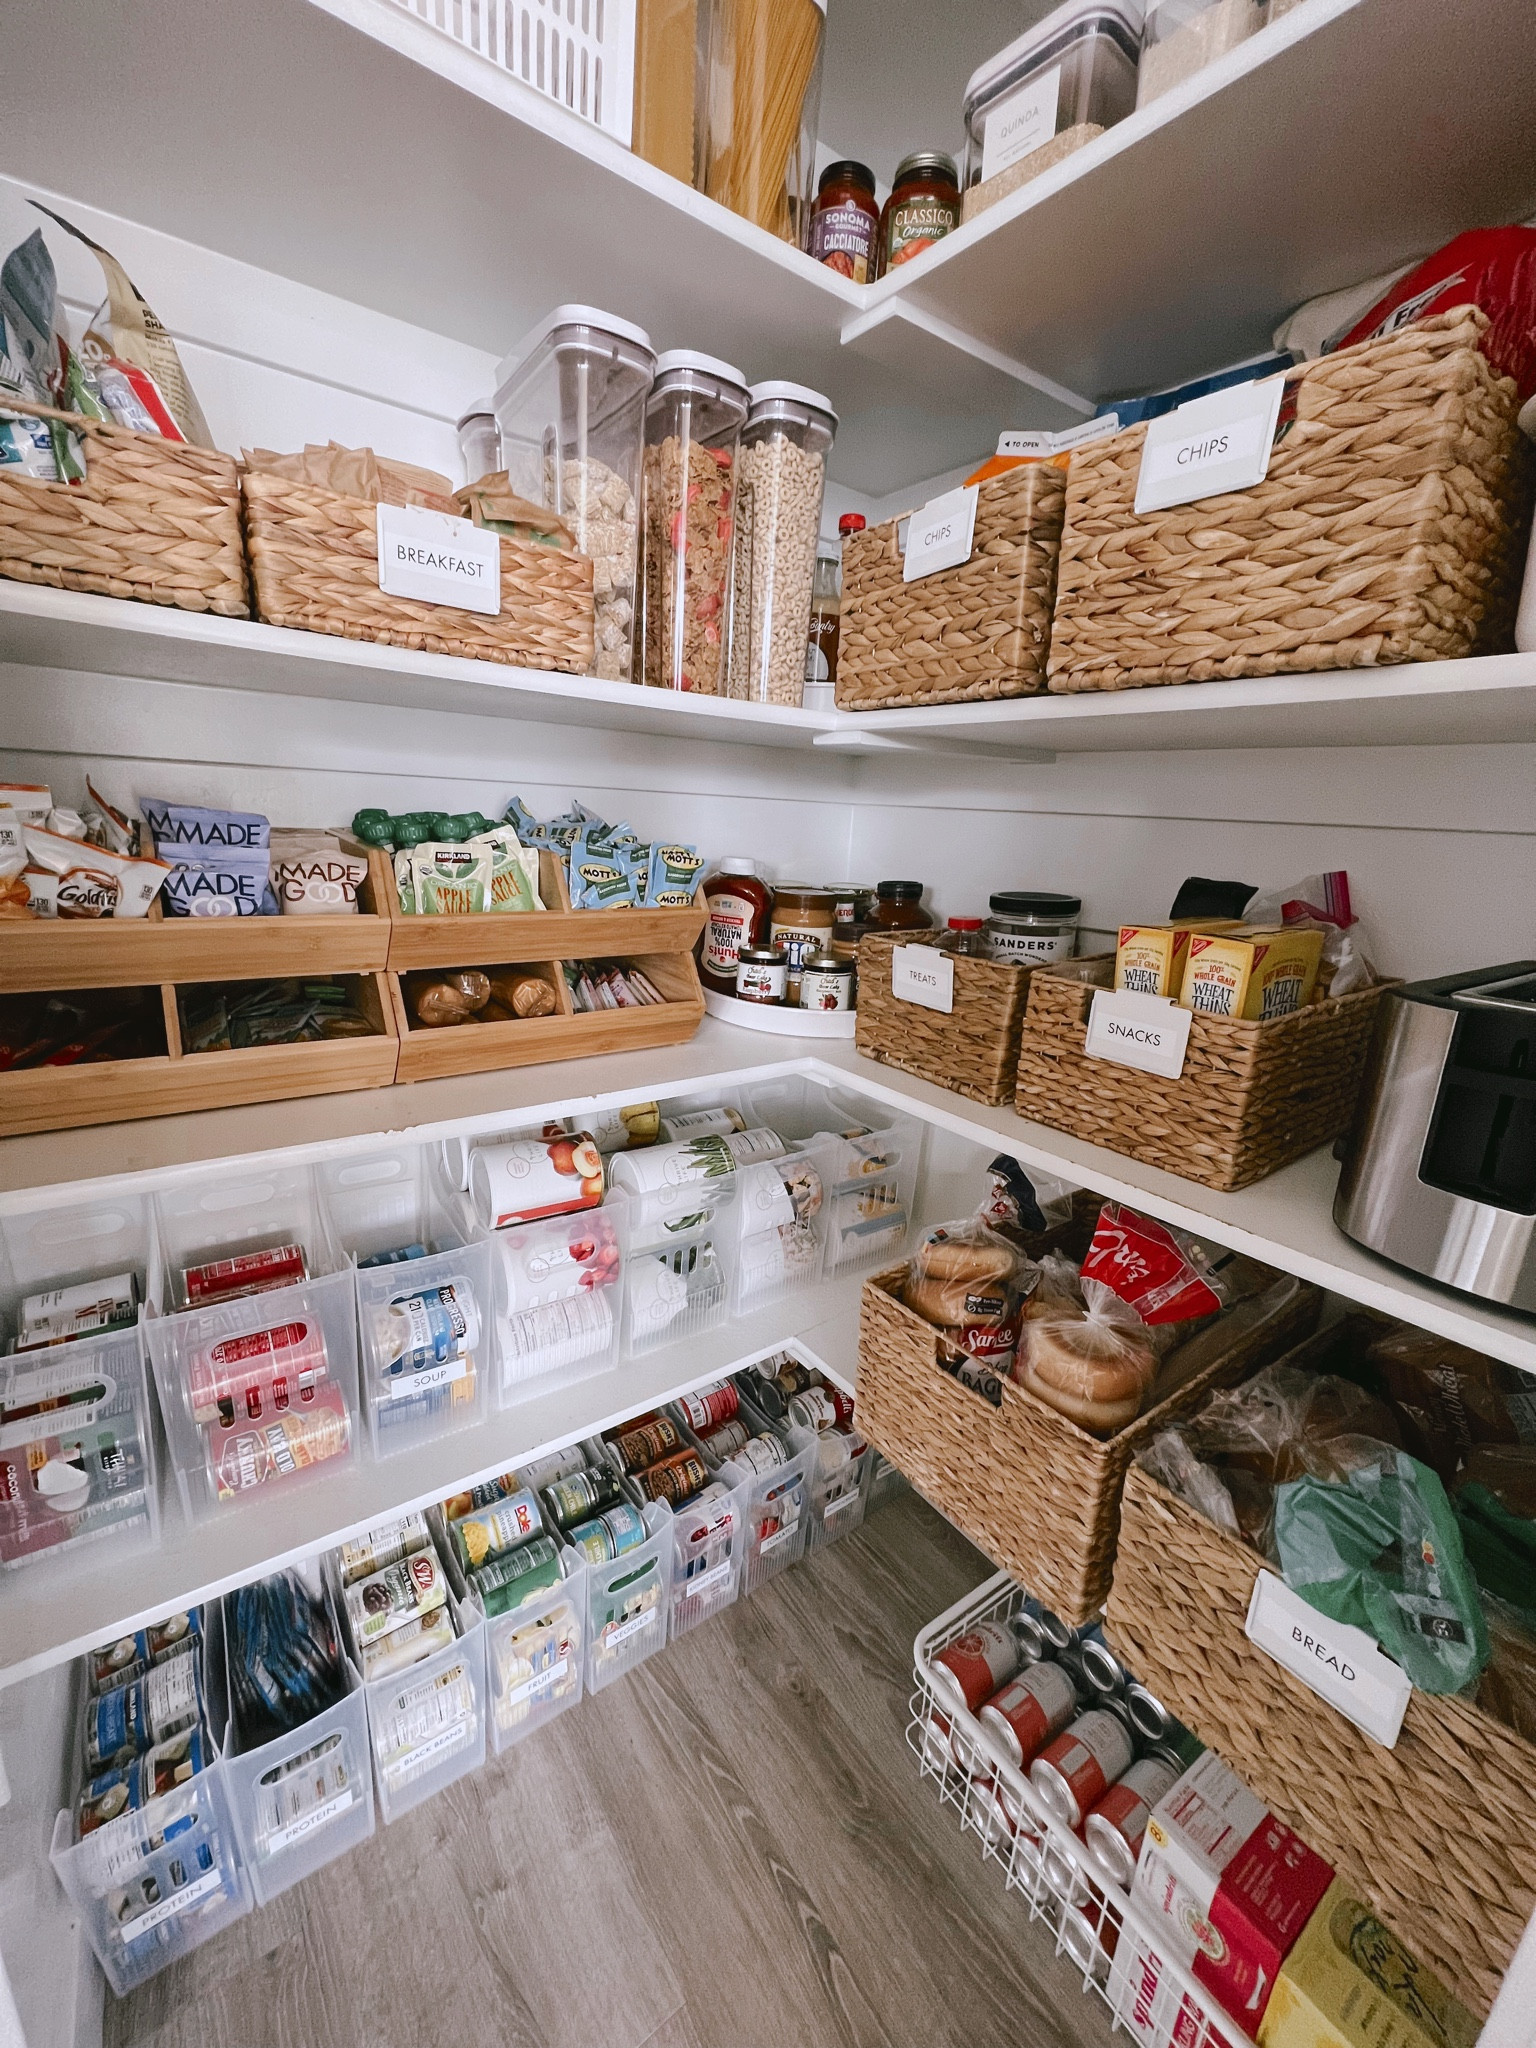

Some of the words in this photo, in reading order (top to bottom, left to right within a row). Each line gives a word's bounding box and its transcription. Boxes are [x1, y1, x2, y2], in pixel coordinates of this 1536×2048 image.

[1000, 105, 1040, 139] QUINOA
[825, 212, 870, 231] SONOMA
[895, 208, 953, 226] CLASSICO
[902, 226, 944, 238] Organic
[823, 233, 869, 255] CACCIATORE
[1177, 435, 1229, 465] CHIPS
[924, 524, 951, 546] CHIPS
[397, 544, 484, 578] BREAKFAST
[177, 821, 260, 846] MADE
[437, 852, 471, 860] KIRKLAND
[280, 862, 360, 883] MADE
[163, 872, 255, 897] MADE
[436, 887, 472, 901] APPLE
[436, 901, 472, 914] SAUCE
[710, 926, 742, 940] NATURAL
[714, 936, 734, 948] 100%
[777, 933, 817, 943] NATURAL
[994, 936, 1055, 951] SANDERS
[1124, 968, 1160, 985] WHEAT
[1143, 961, 1160, 971] GRAIN
[909, 970, 937, 987] TREATS
[1193, 972, 1215, 981] WHOLE
[1216, 974, 1237, 988] GRAIN
[1193, 982, 1235, 1002] WHEAT
[1262, 979, 1304, 1010] WHEAT
[1191, 995, 1232, 1017] THINS
[1107, 1022, 1161, 1047] SNACKS
[439, 1288, 466, 1336] PROGRESSO
[413, 1370, 447, 1388] SOUP
[659, 1422, 674, 1445] BUSH'S
[235, 1437, 258, 1489] CHUNKY
[688, 1460, 702, 1487] BUSH'S
[504, 1510, 516, 1541] crushed
[516, 1504, 532, 1533] Dole
[404, 1580, 415, 1604] BEANS
[613, 1614, 649, 1640] VEGGIES
[1291, 1625, 1356, 1681] BREAD
[528, 1671, 552, 1692] FRUIT
[403, 1746, 432, 1767] BLACK
[433, 1727, 463, 1748] BEANS
[285, 1803, 338, 1840] PROTEIN
[1150, 1825, 1162, 1842] 8
[142, 1883, 203, 1927] PROTEIN
